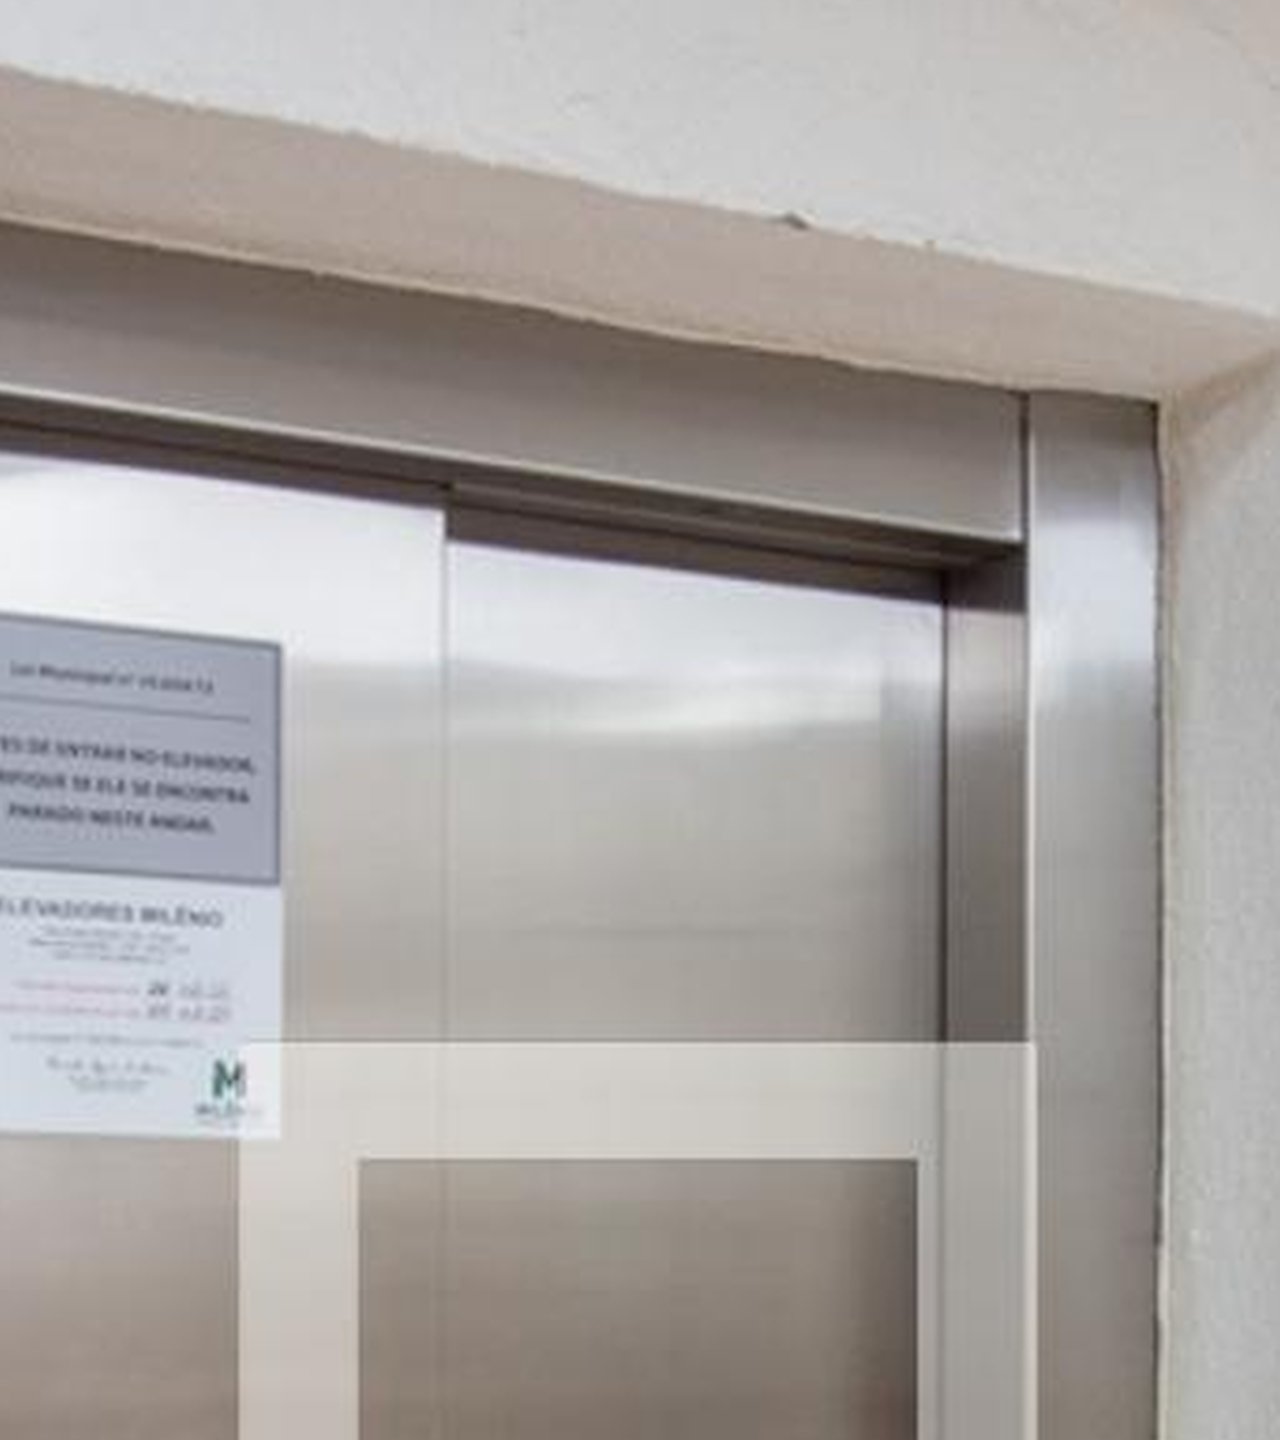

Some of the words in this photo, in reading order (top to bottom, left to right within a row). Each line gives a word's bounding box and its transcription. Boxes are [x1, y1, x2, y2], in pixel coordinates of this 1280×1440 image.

[27, 737, 49, 756] DE
[55, 739, 125, 764] ENTRAR
[129, 747, 158, 766] NO
[71, 773, 92, 792] SE
[96, 776, 125, 796] ELE
[131, 778, 151, 798] SE
[155, 780, 250, 804] ENCONTRA
[8, 802, 84, 823] PARADO
[90, 809, 144, 829] NESTE
[139, 903, 224, 930] MILÊNIO
